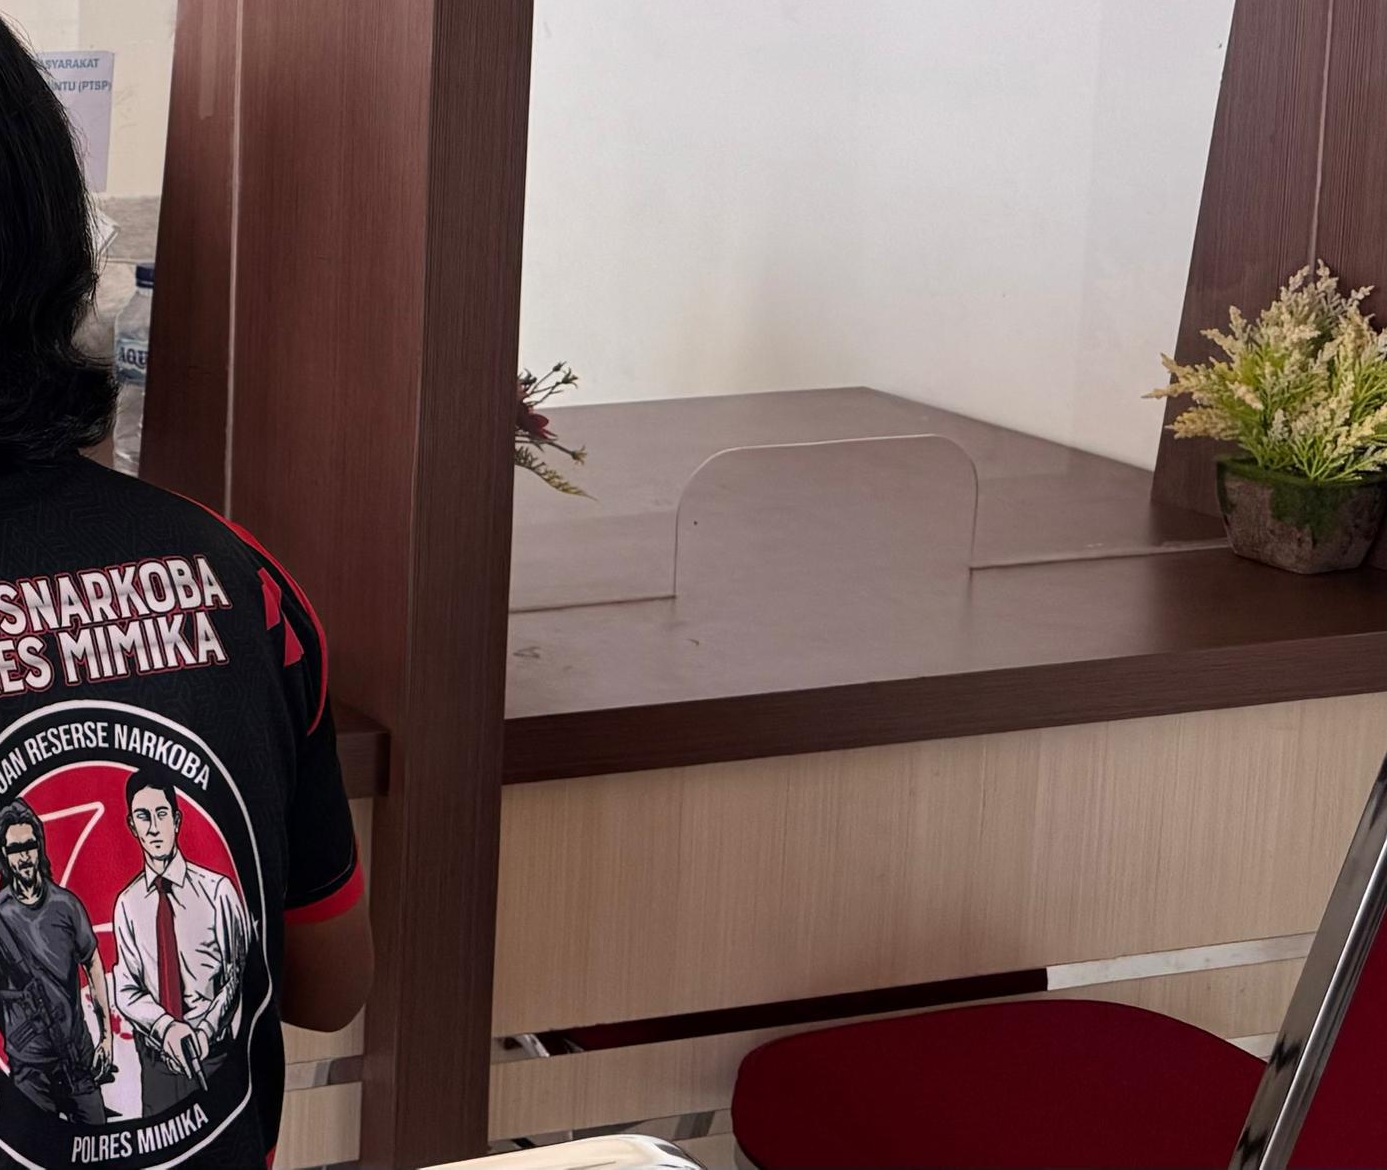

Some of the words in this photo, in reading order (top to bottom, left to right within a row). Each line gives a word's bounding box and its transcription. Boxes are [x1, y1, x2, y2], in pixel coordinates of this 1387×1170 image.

[52, 80, 76, 92] NTU
[118, 347, 148, 369] AQU
[57, 611, 228, 683] MIMIKA
[23, 721, 109, 766] RESERSE
[113, 723, 211, 791] NARKOBA
[70, 1130, 133, 1164] POLRES
[136, 1102, 209, 1155] MIMIKA
